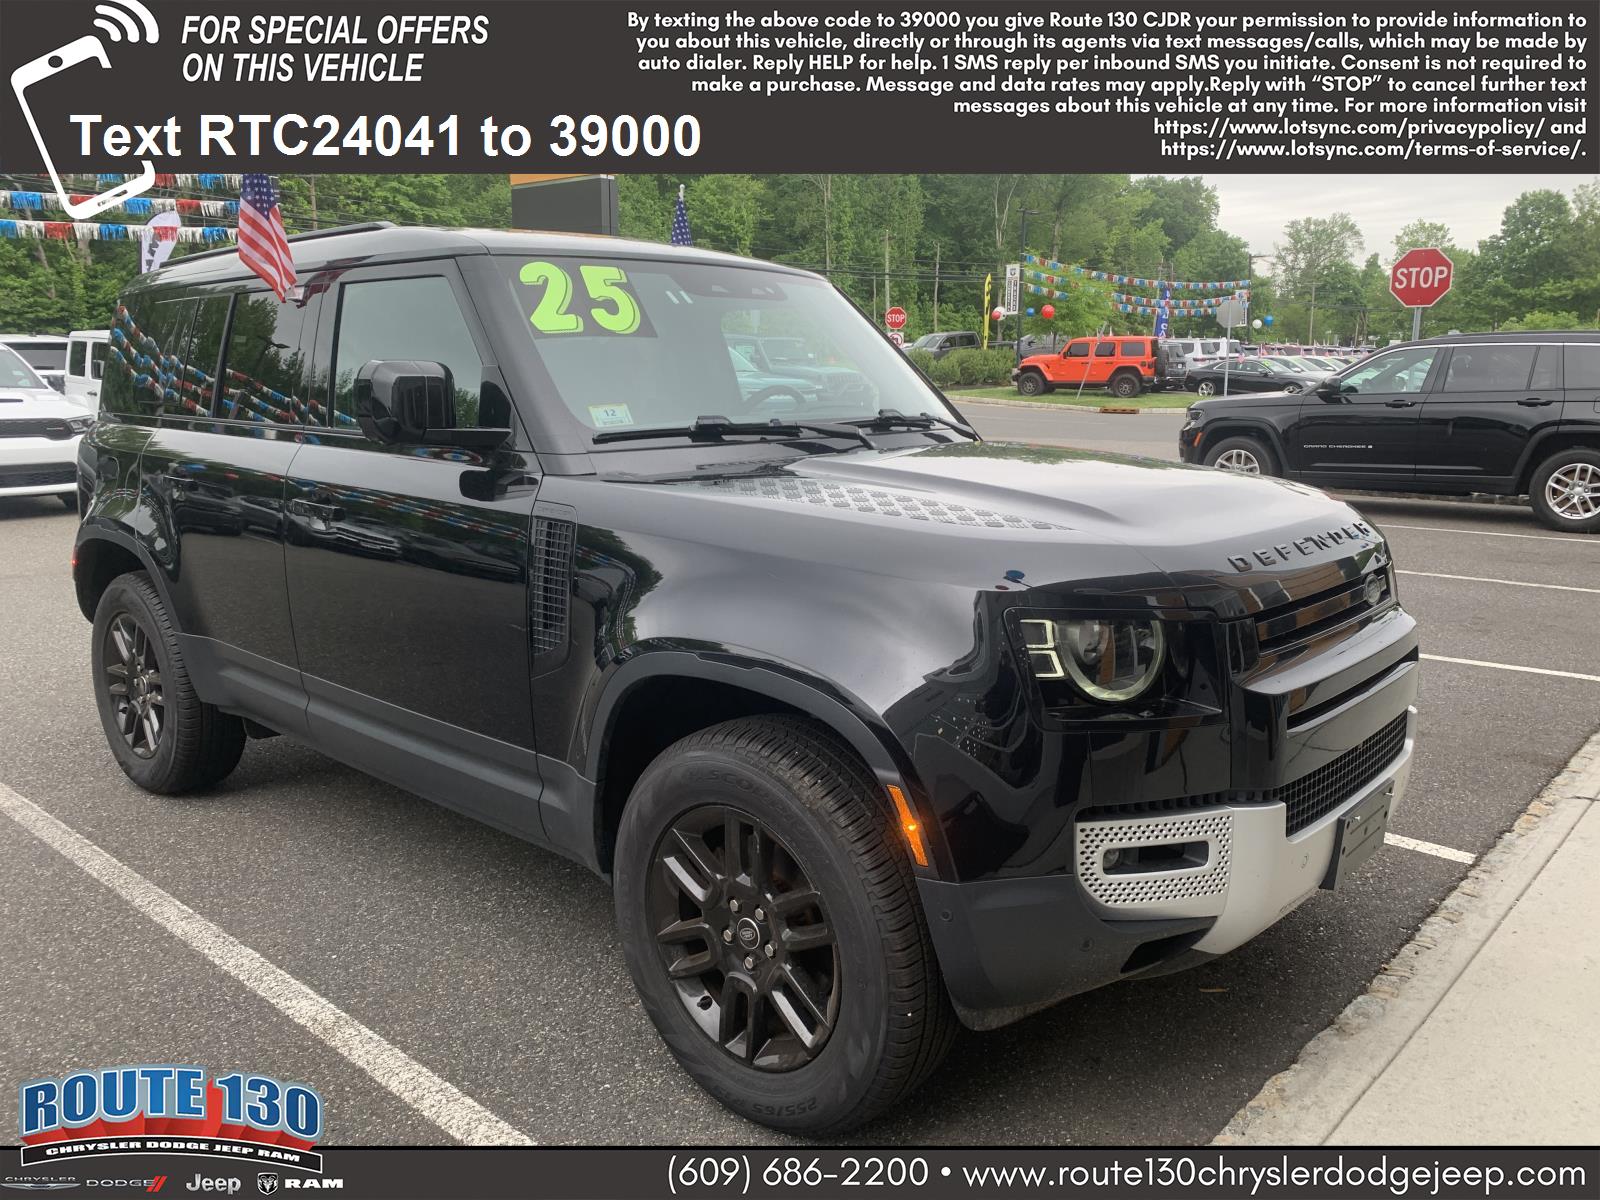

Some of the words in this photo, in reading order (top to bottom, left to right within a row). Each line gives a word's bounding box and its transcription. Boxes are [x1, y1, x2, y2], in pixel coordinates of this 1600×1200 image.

[1394, 265, 1448, 289] STOP
[519, 261, 641, 334] 25
[887, 313, 905, 323] STOP
[604, 409, 617, 417] 12
[1228, 522, 1371, 573] DEFENDER
